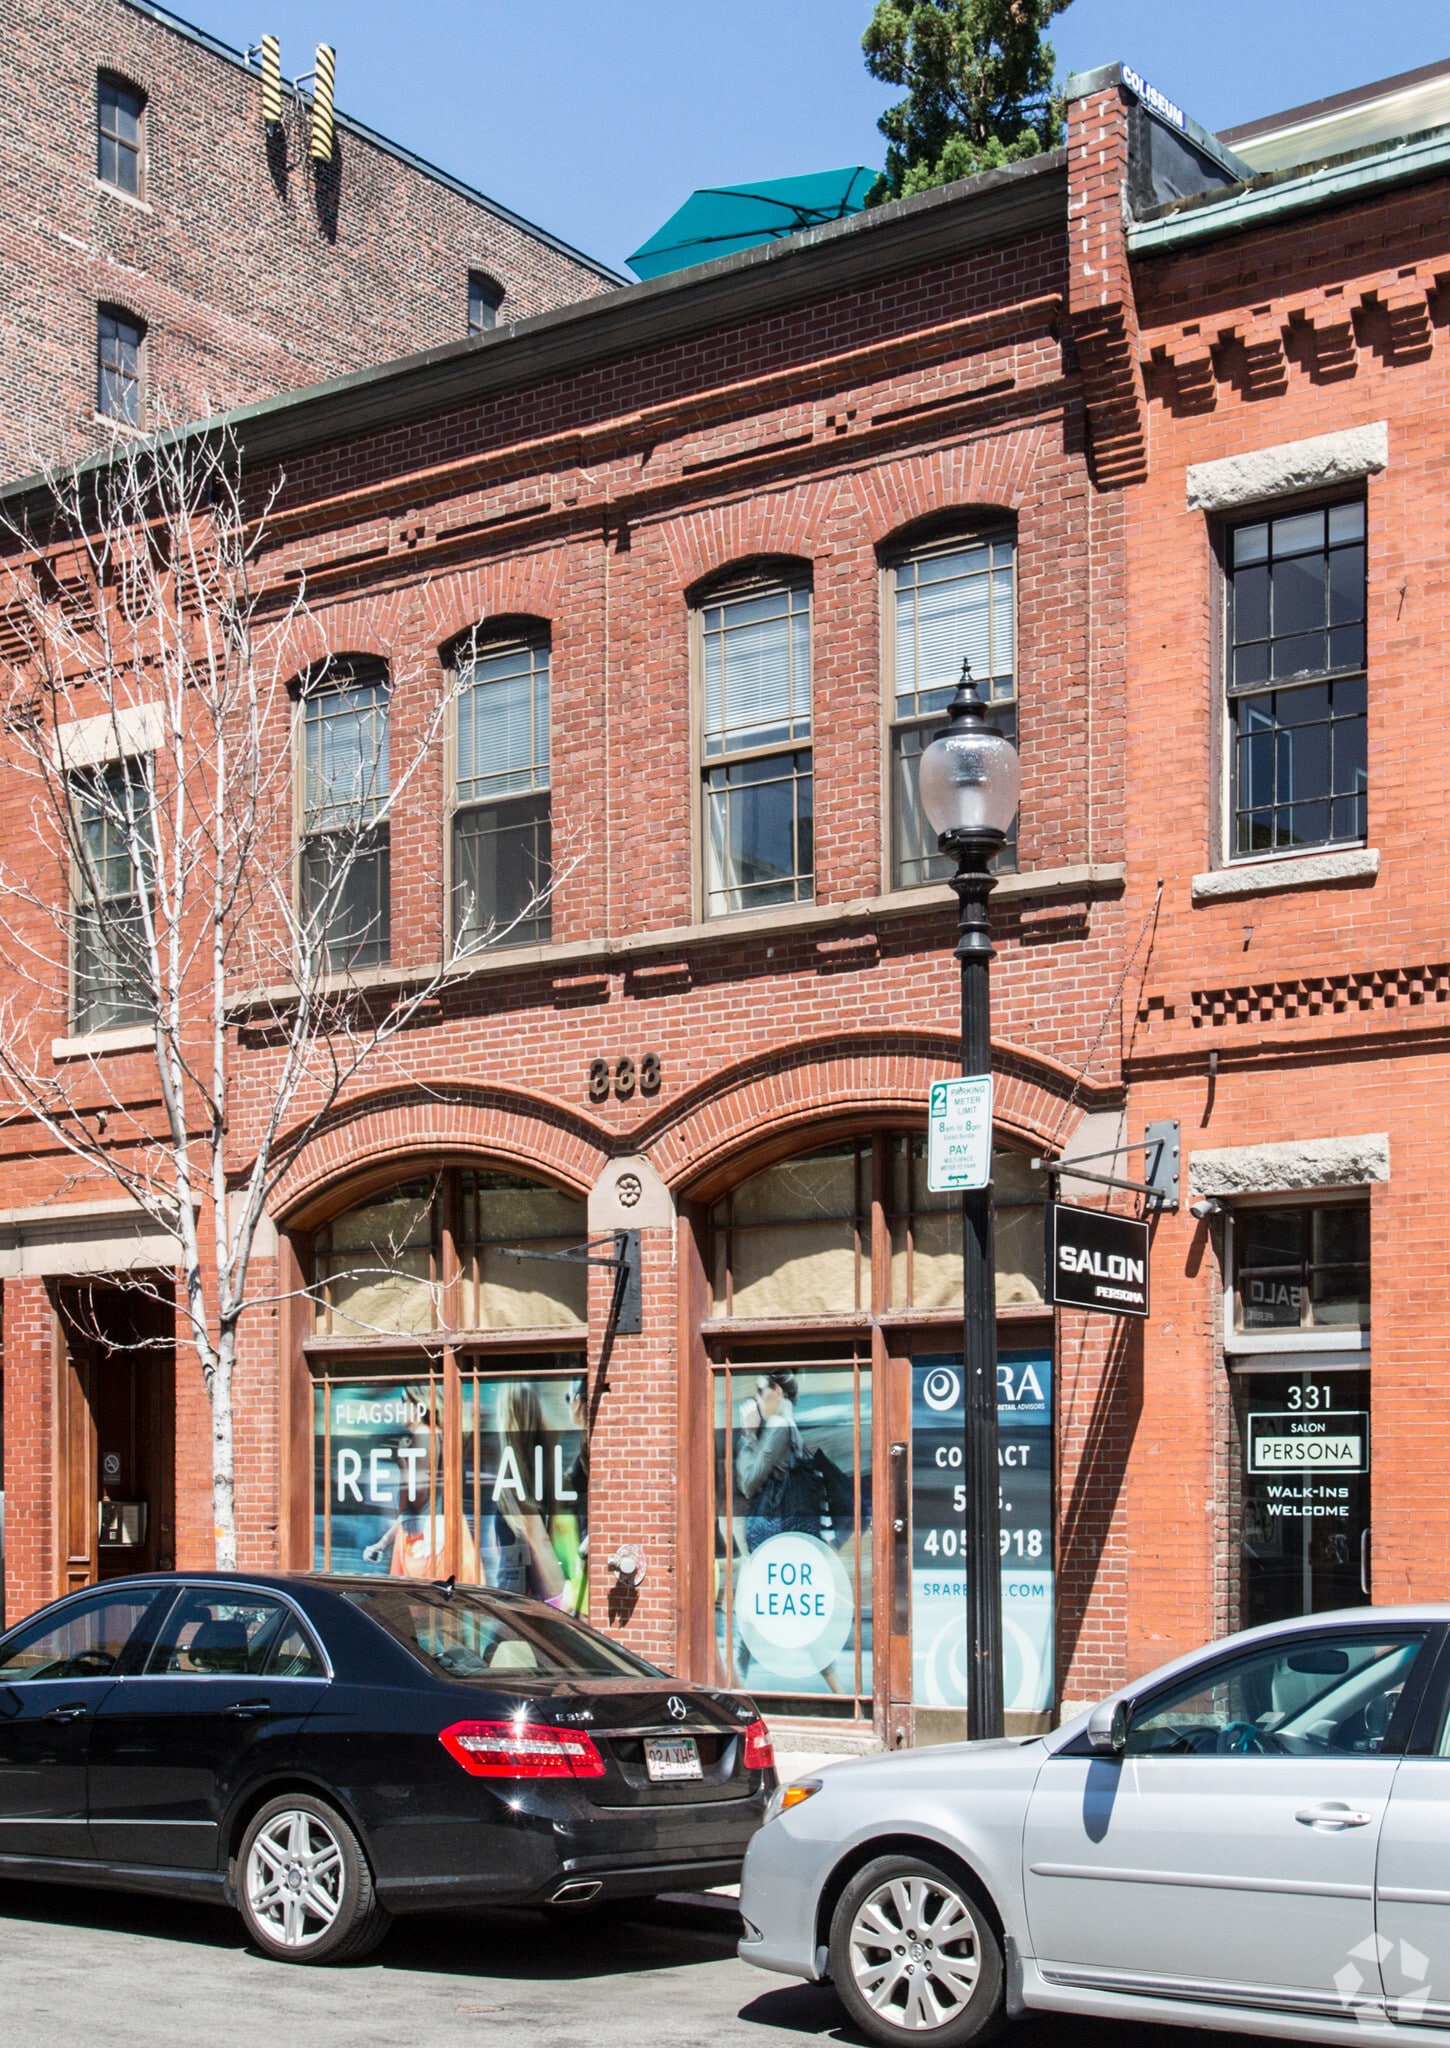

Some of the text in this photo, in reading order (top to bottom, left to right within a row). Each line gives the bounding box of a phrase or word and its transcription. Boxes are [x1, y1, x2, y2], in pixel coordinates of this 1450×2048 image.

[1122, 65, 1184, 128] COLISEUM
[589, 1052, 661, 1096] 333
[933, 1087, 946, 1109] 2
[951, 1086, 985, 1095] PARKING
[954, 1096, 981, 1106] METER
[957, 1106, 978, 1115] LIMIT
[949, 1145, 968, 1155] PAY
[1059, 1245, 1144, 1284] SALON
[1095, 1286, 1144, 1304] PERSONA
[996, 1364, 1045, 1401] RA
[1017, 1403, 1045, 1411] ADVISORS
[1287, 1385, 1331, 1410] 331
[335, 1402, 427, 1424] FLAGSHIP
[1290, 1423, 1326, 1433] SALON
[935, 1445, 1030, 1468] COCT
[1262, 1443, 1353, 1460] PERSONA
[1267, 1504, 1349, 1517] WELCOME
[767, 1563, 813, 1586] FOR
[755, 1593, 825, 1617] LEASE
